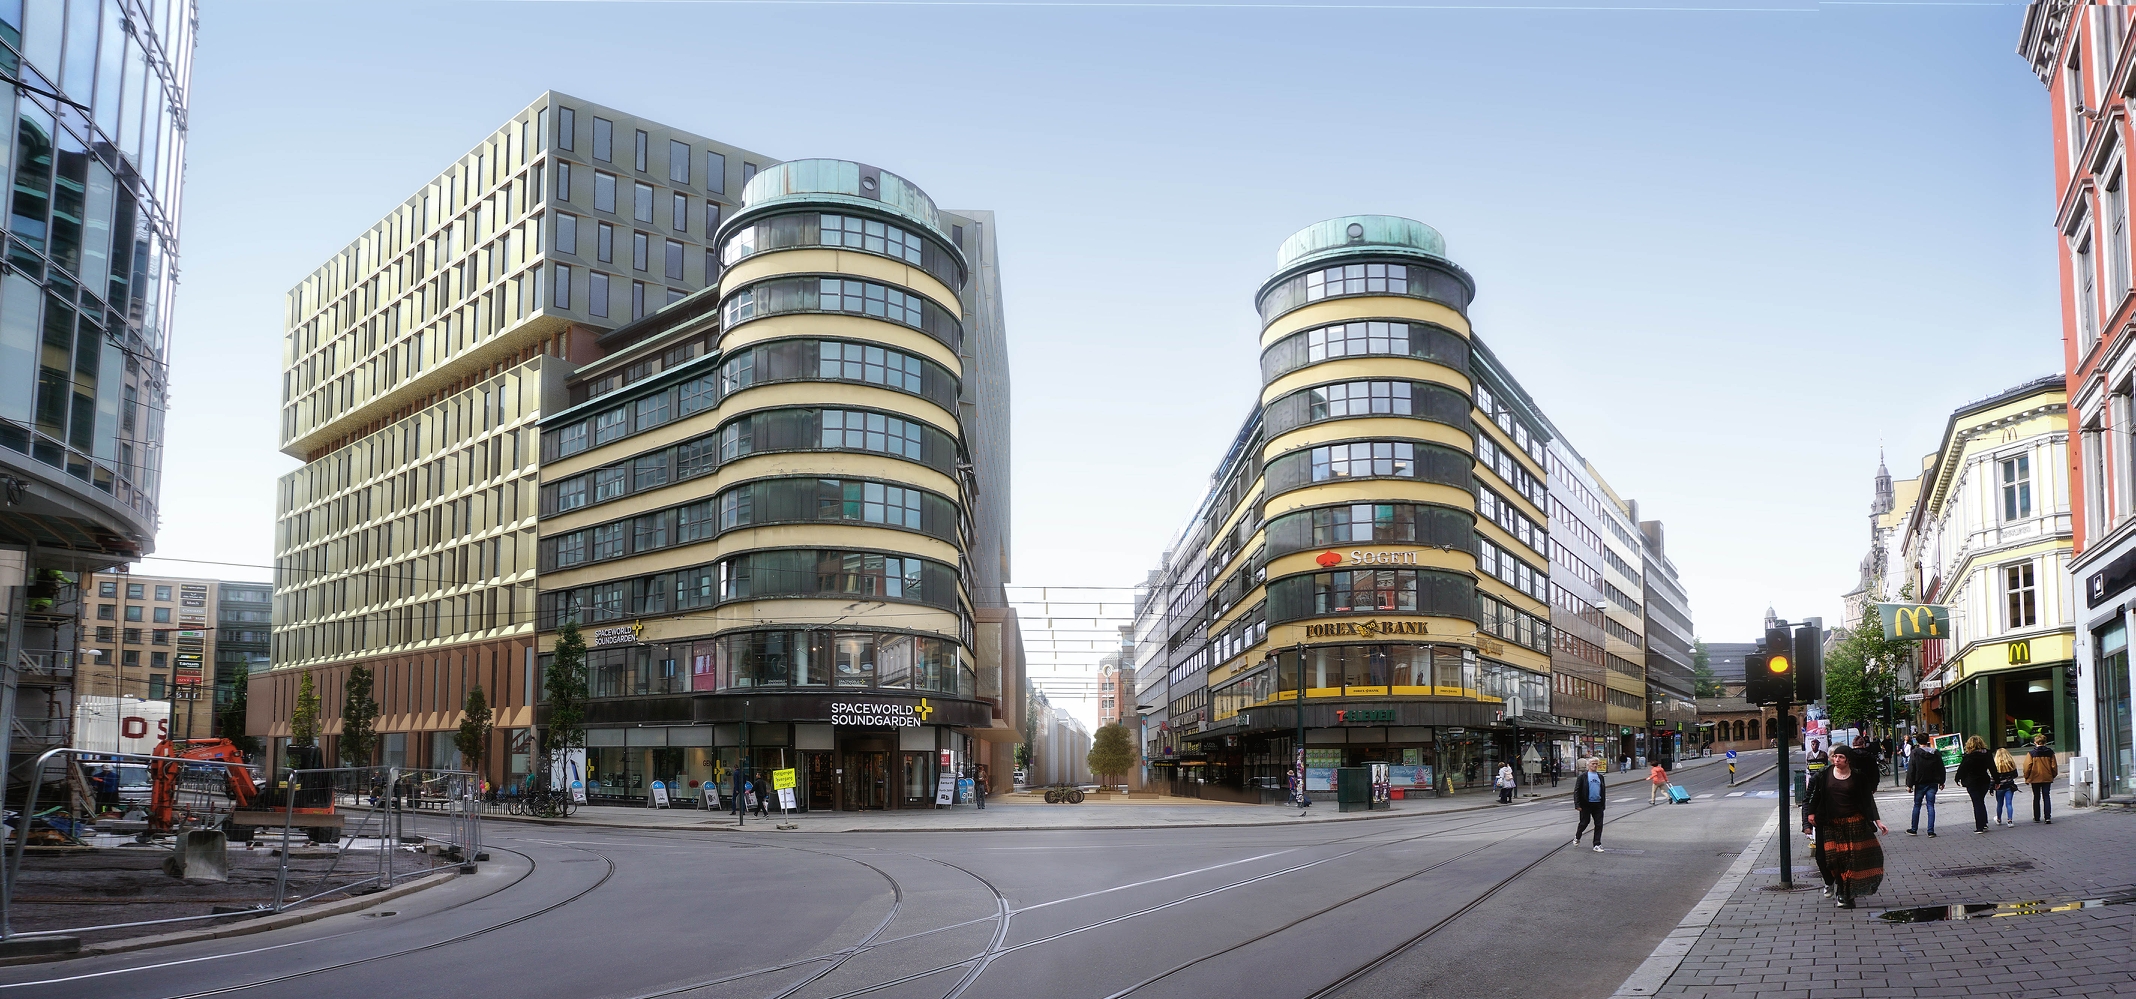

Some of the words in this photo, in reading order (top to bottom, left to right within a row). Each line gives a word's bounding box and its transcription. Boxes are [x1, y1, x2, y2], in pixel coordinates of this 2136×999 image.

[1350, 550, 1418, 565] SOGETI
[594, 626, 632, 638] SPACEWORLD
[1306, 622, 1357, 637] FOREX
[1381, 621, 1429, 635] BANK
[594, 634, 636, 646] SOUNDGARDEN
[831, 702, 914, 716] SPACEWORLD
[831, 714, 921, 727] SOUNDGARDEN
